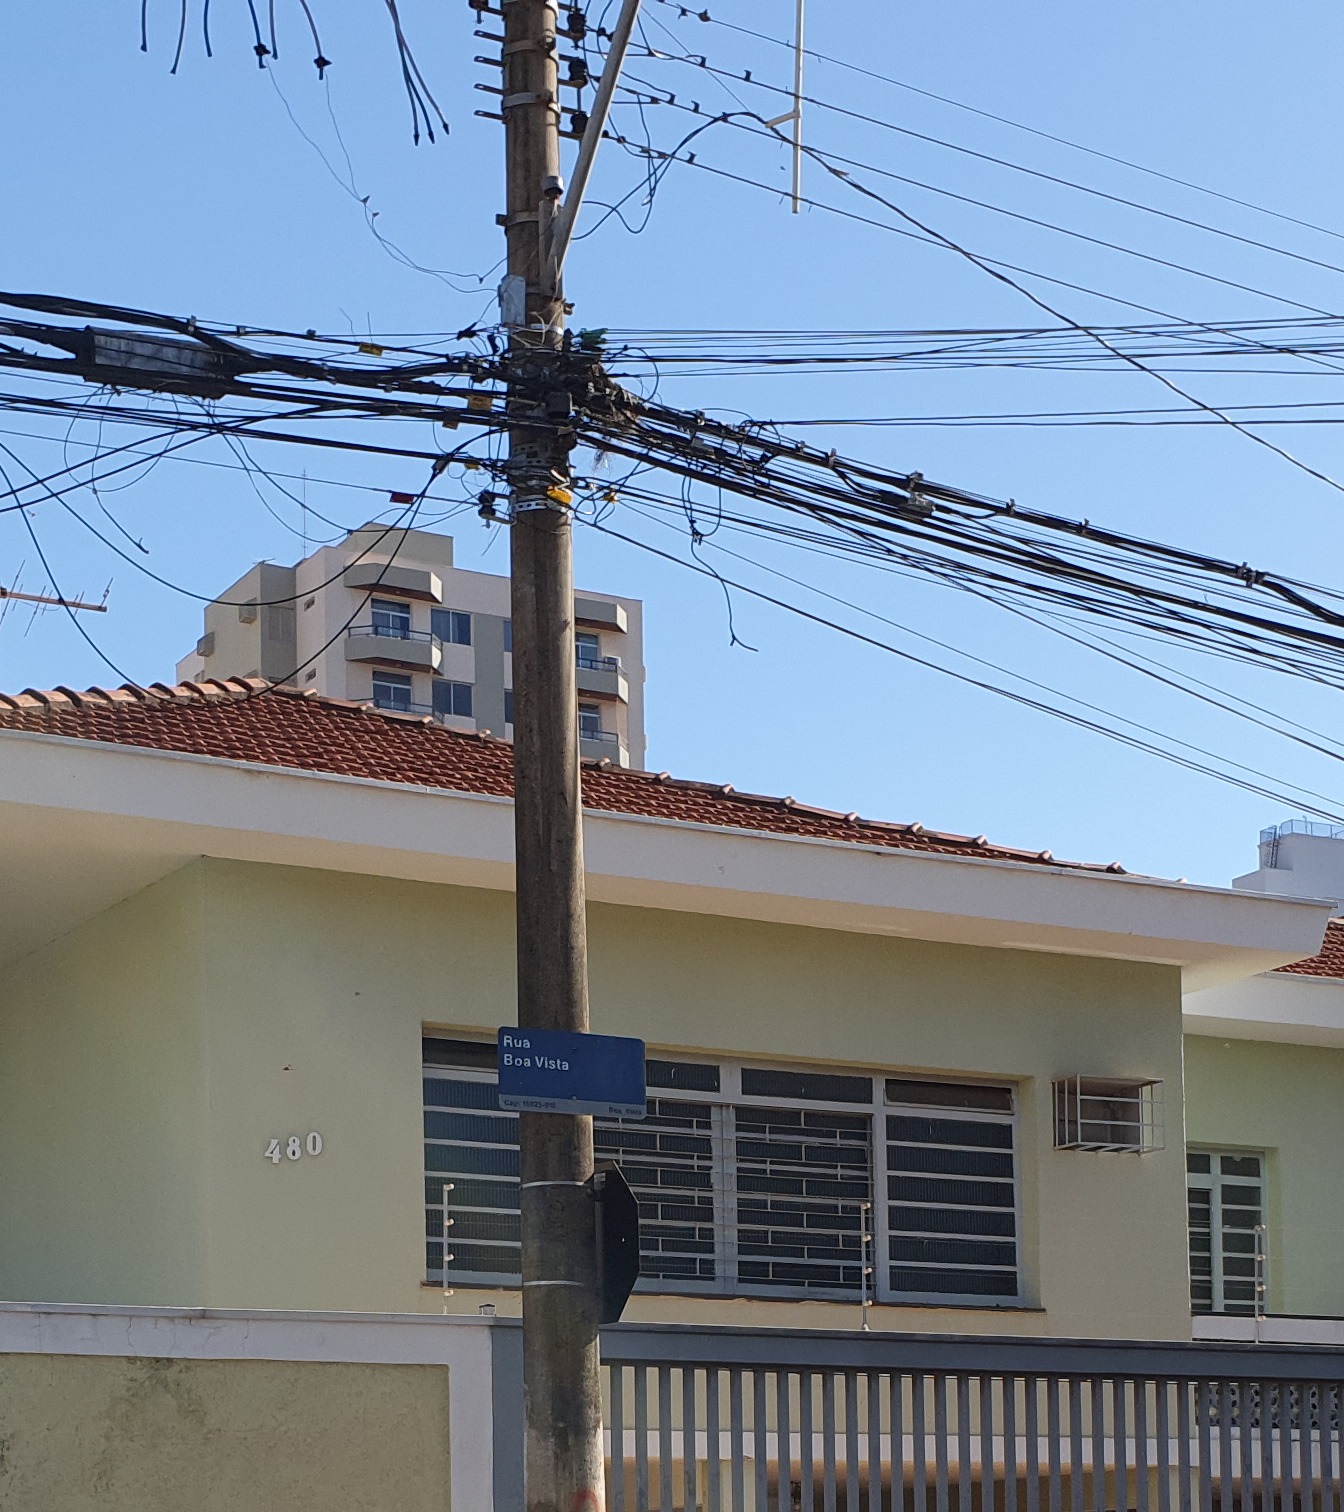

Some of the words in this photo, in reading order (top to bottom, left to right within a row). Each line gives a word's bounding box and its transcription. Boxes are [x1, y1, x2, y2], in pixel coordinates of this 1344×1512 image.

[503, 1035, 531, 1049] Rua
[504, 1053, 531, 1068] Boa
[535, 1055, 569, 1071] Vista
[264, 1131, 323, 1164] 480
